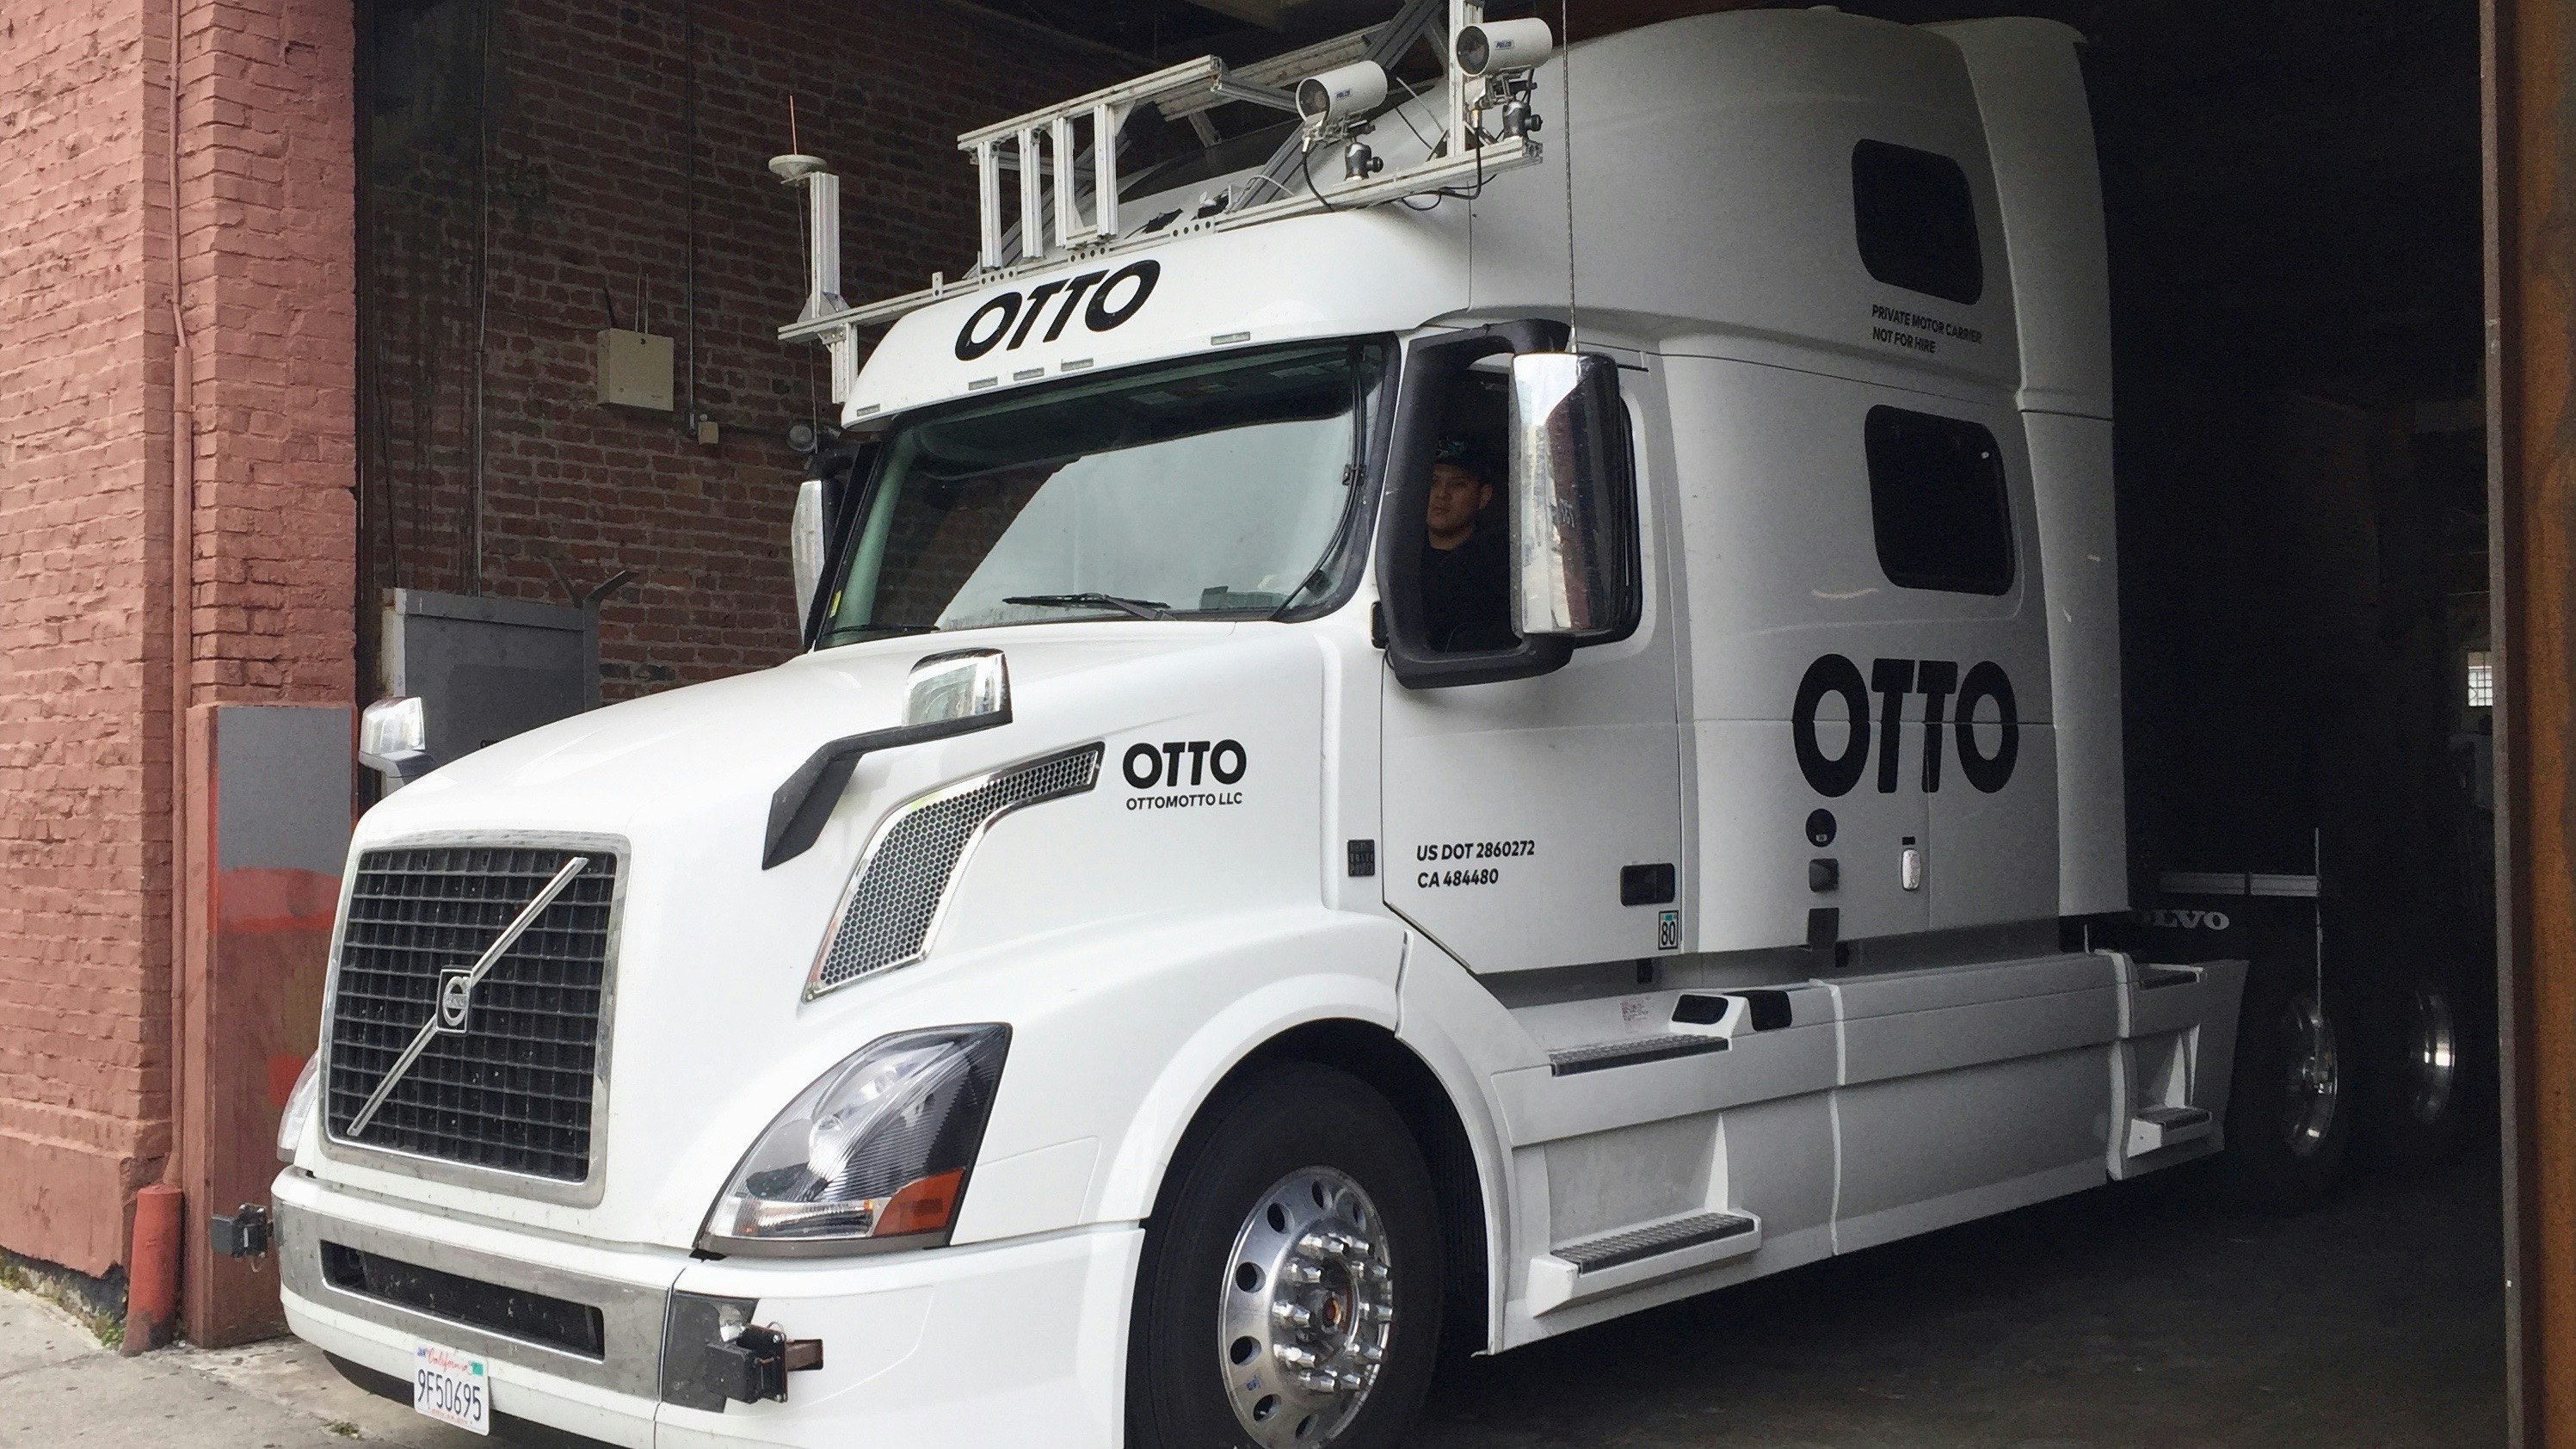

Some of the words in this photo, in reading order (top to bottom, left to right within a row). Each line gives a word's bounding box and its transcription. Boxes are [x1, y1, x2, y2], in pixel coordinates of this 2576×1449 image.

[955, 259, 1162, 361] OTTO
[1872, 304, 1911, 326] PRIVATE
[1912, 313, 1944, 335] MOTOR
[1945, 323, 1982, 344] CARRIER
[1872, 326, 1894, 343] NOT
[1894, 331, 1914, 348] FOR
[1914, 336, 1936, 353] HIRE
[1792, 653, 2019, 798] OTTO
[1122, 739, 1247, 789] OTTO
[1126, 793, 1216, 811] OTTOMOTTO
[1218, 792, 1243, 805] LLC
[1416, 844, 1439, 861] US
[1441, 842, 1474, 860] DOT
[1476, 840, 1535, 859] 2860272
[1417, 872, 1440, 888] CA
[1443, 868, 1499, 887] 484480
[1661, 921, 1676, 946] 80
[417, 1368, 482, 1421] 9F50695
